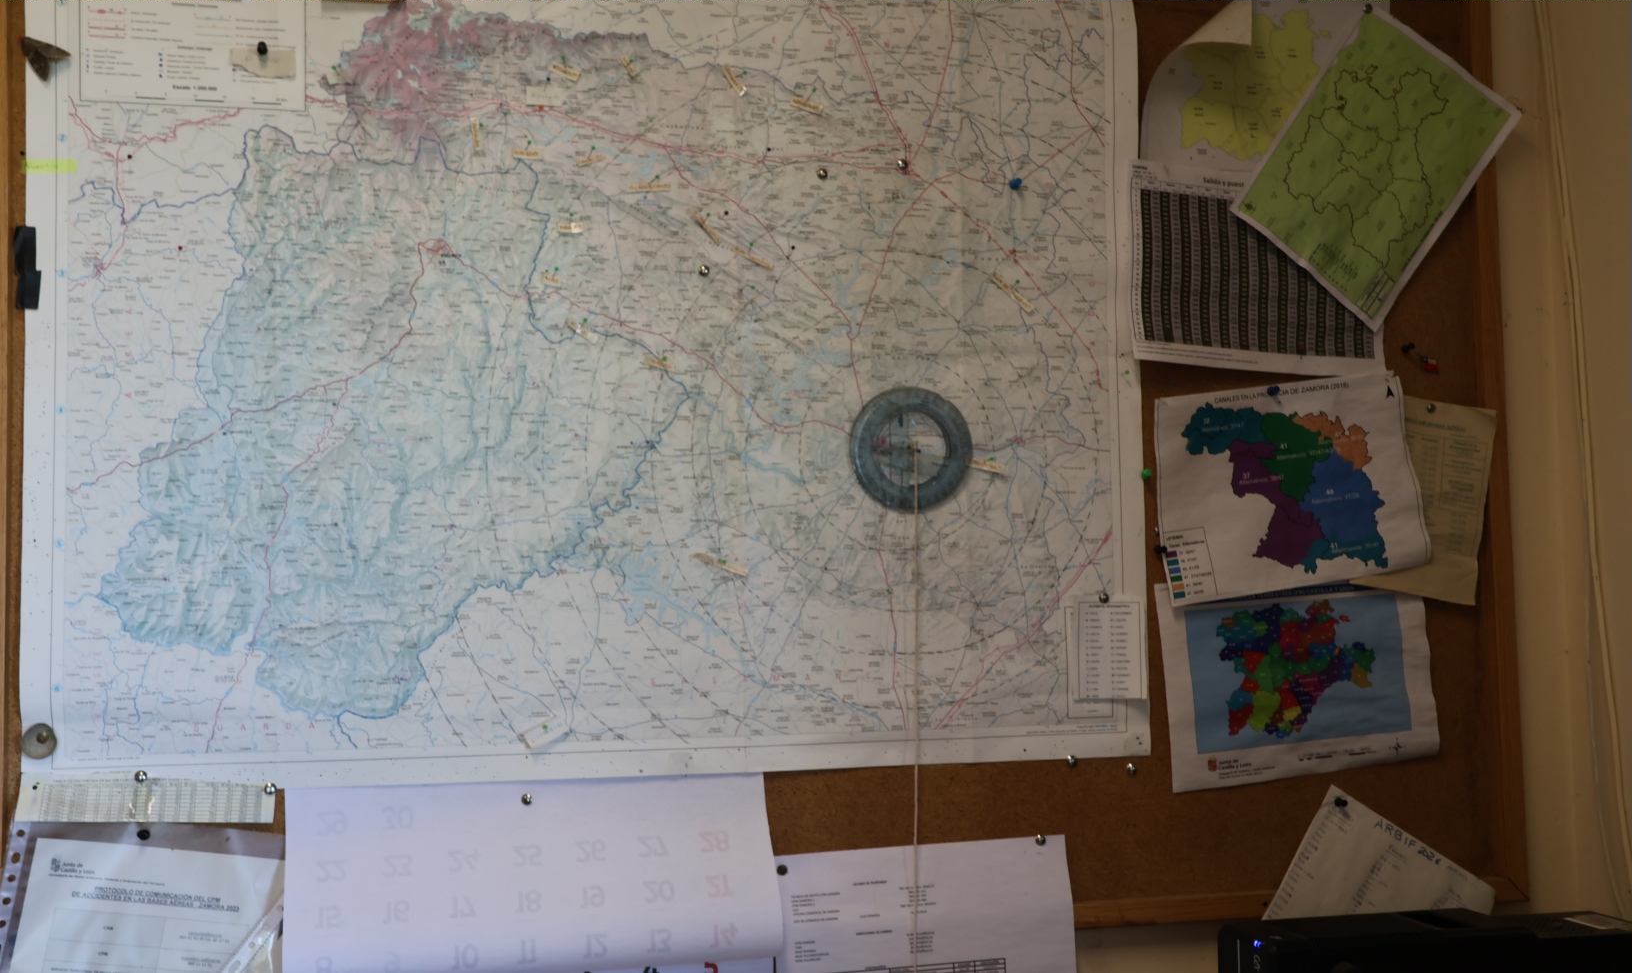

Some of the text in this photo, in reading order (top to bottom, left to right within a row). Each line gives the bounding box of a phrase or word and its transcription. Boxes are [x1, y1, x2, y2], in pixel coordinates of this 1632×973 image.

[1203, 177, 1222, 186] Salida
[1222, 180, 1227, 188] y
[1215, 396, 1240, 404] CANALES
[1301, 385, 1330, 394] ZAMORA
[72, 890, 80, 898] DE
[82, 891, 122, 901] ACCIDENTES
[146, 896, 167, 905] BASES
[199, 901, 225, 911] ZAMORA
[95, 886, 134, 896] PROTOCOLO
[193, 894, 205, 902] DEL
